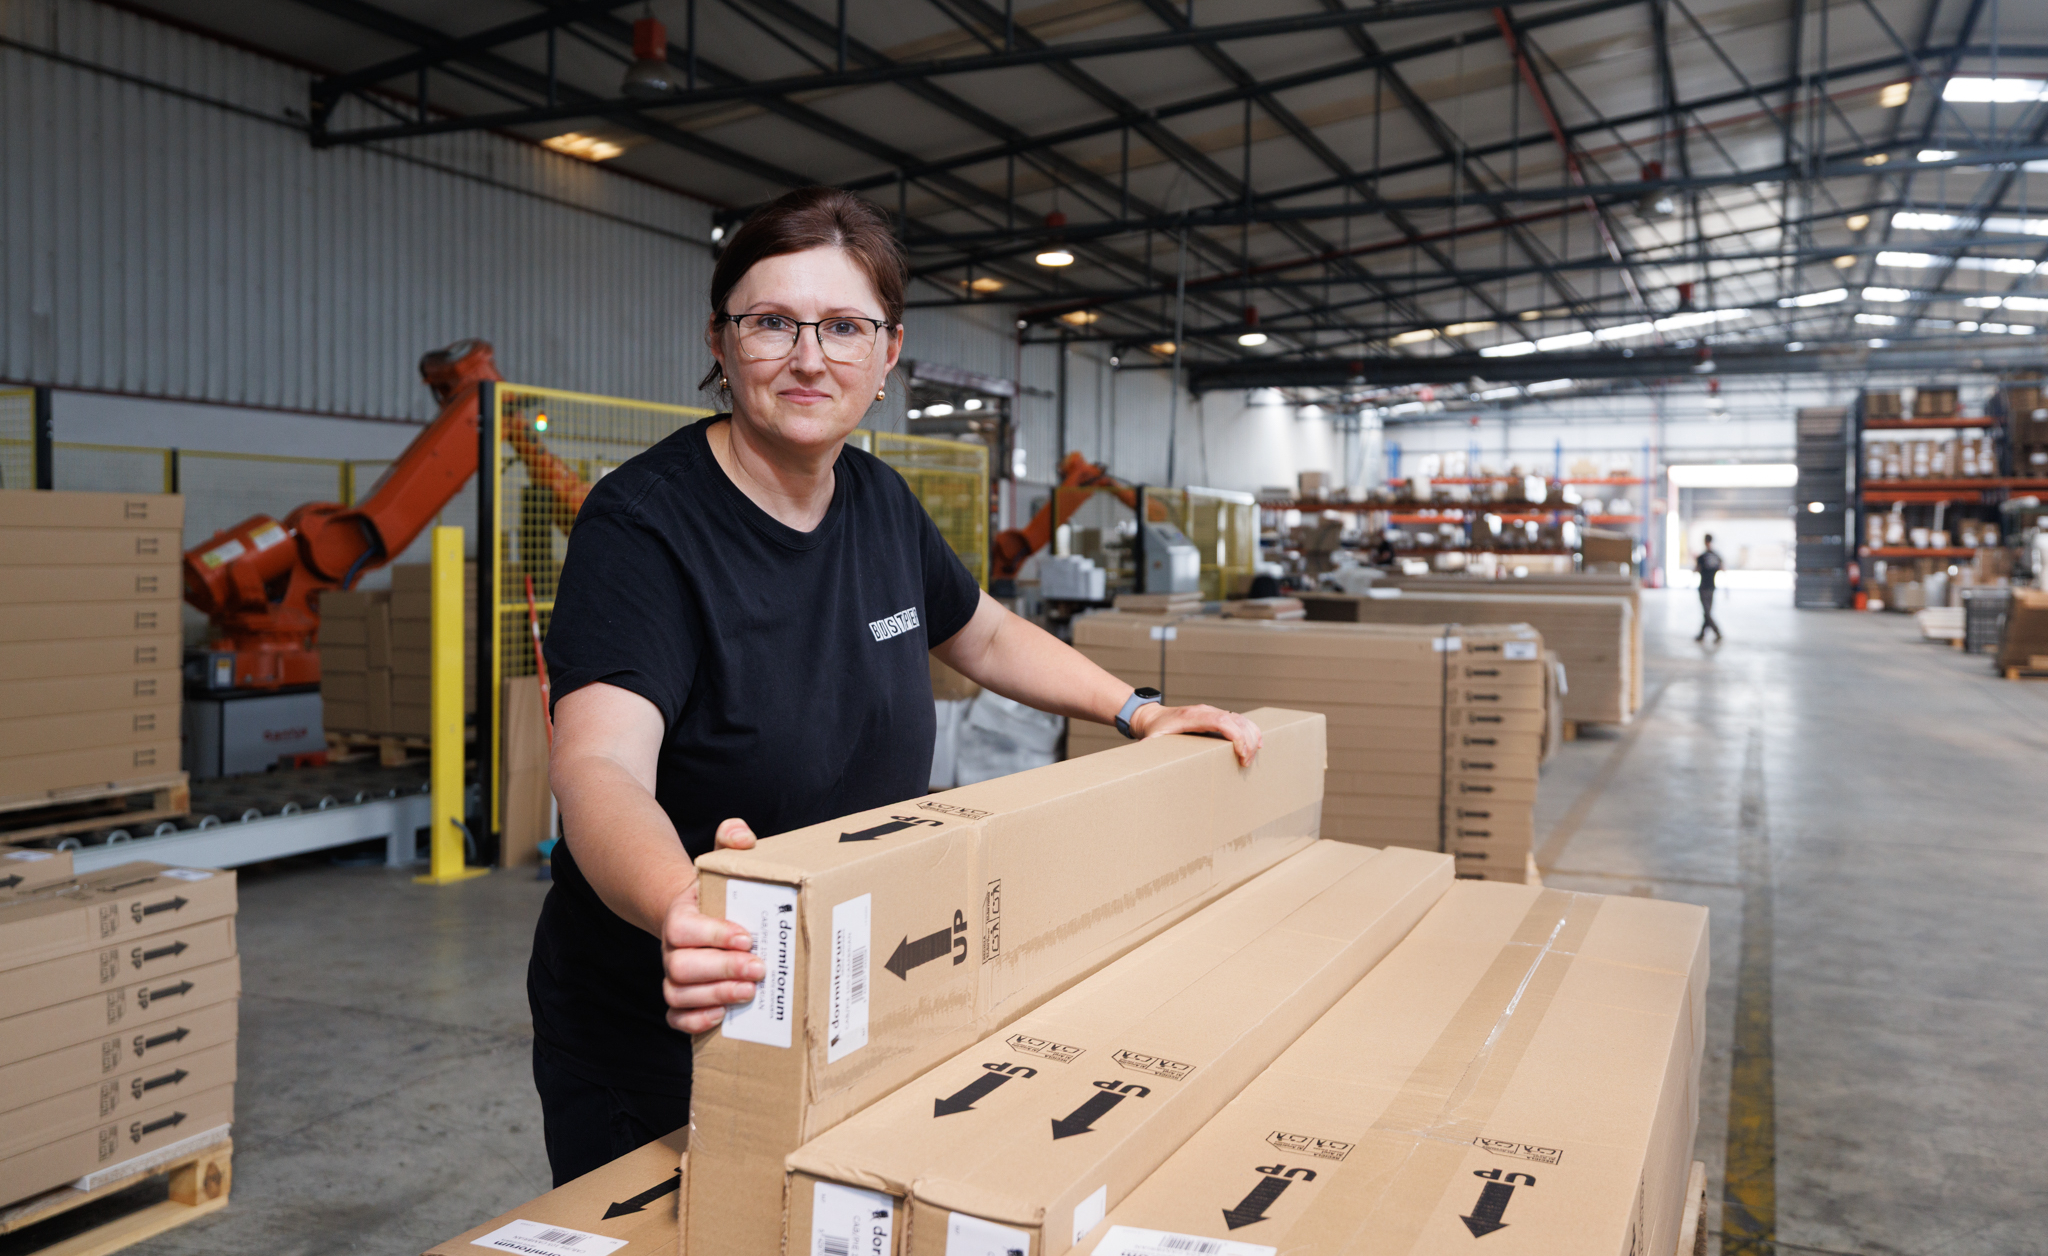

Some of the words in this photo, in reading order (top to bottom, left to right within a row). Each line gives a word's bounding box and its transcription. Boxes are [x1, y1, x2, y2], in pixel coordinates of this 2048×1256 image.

[890, 815, 945, 828] UP
[130, 901, 142, 924] UP
[953, 907, 968, 967] UP
[130, 946, 142, 970] UP
[776, 919, 792, 1021] dormitorum
[832, 929, 842, 1029] dormitorum
[137, 987, 149, 1010] UP
[133, 1035, 145, 1057] UP
[982, 1061, 1038, 1079] UP
[131, 1078, 142, 1100] UP
[1092, 1079, 1151, 1098] UP
[129, 1121, 141, 1144] UP
[1254, 1163, 1317, 1182] UP
[1473, 1168, 1536, 1187] UP
[494, 1240, 564, 1256] ormitorum
[872, 1226, 887, 1256] dor
